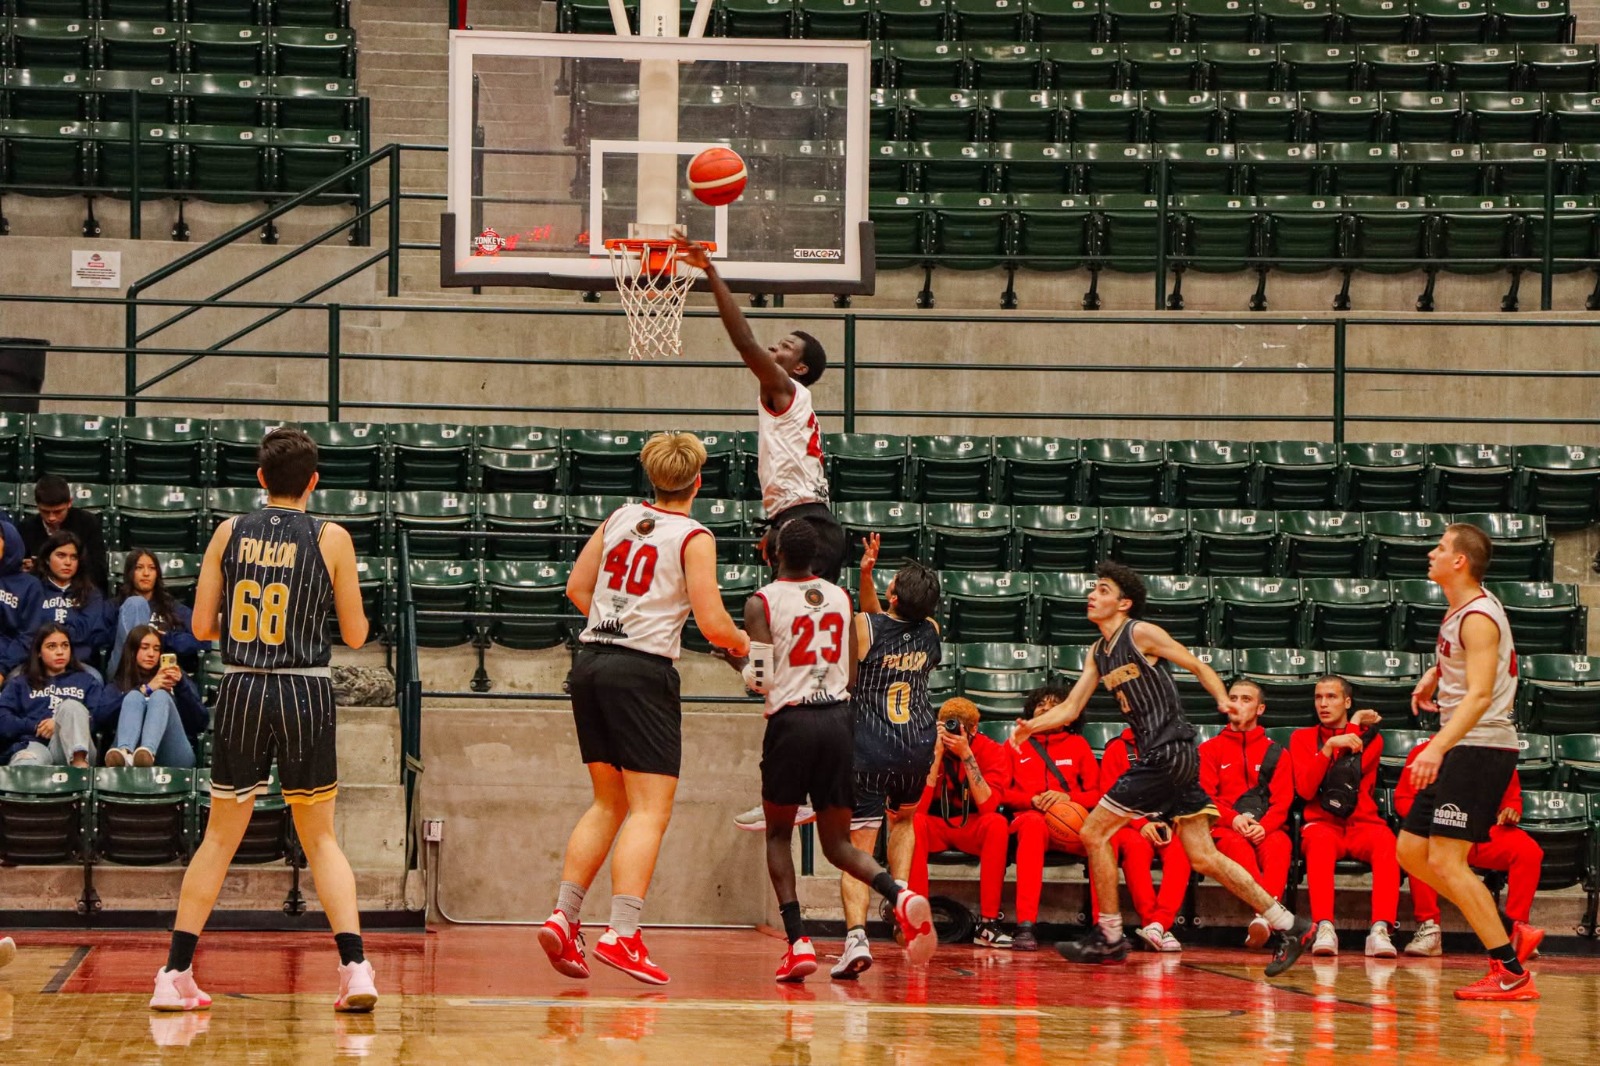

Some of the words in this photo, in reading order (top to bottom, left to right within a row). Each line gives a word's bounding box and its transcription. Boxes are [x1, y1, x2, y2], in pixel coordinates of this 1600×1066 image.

[474, 236, 506, 246] ZONKEYS
[238, 538, 296, 568] FOLKLOR
[604, 538, 658, 596] 40
[230, 579, 289, 646] 68
[788, 612, 844, 667] 23
[29, 684, 84, 699] JAGUARES
[886, 682, 911, 724] 0
[1434, 808, 1468, 821] COOPER
